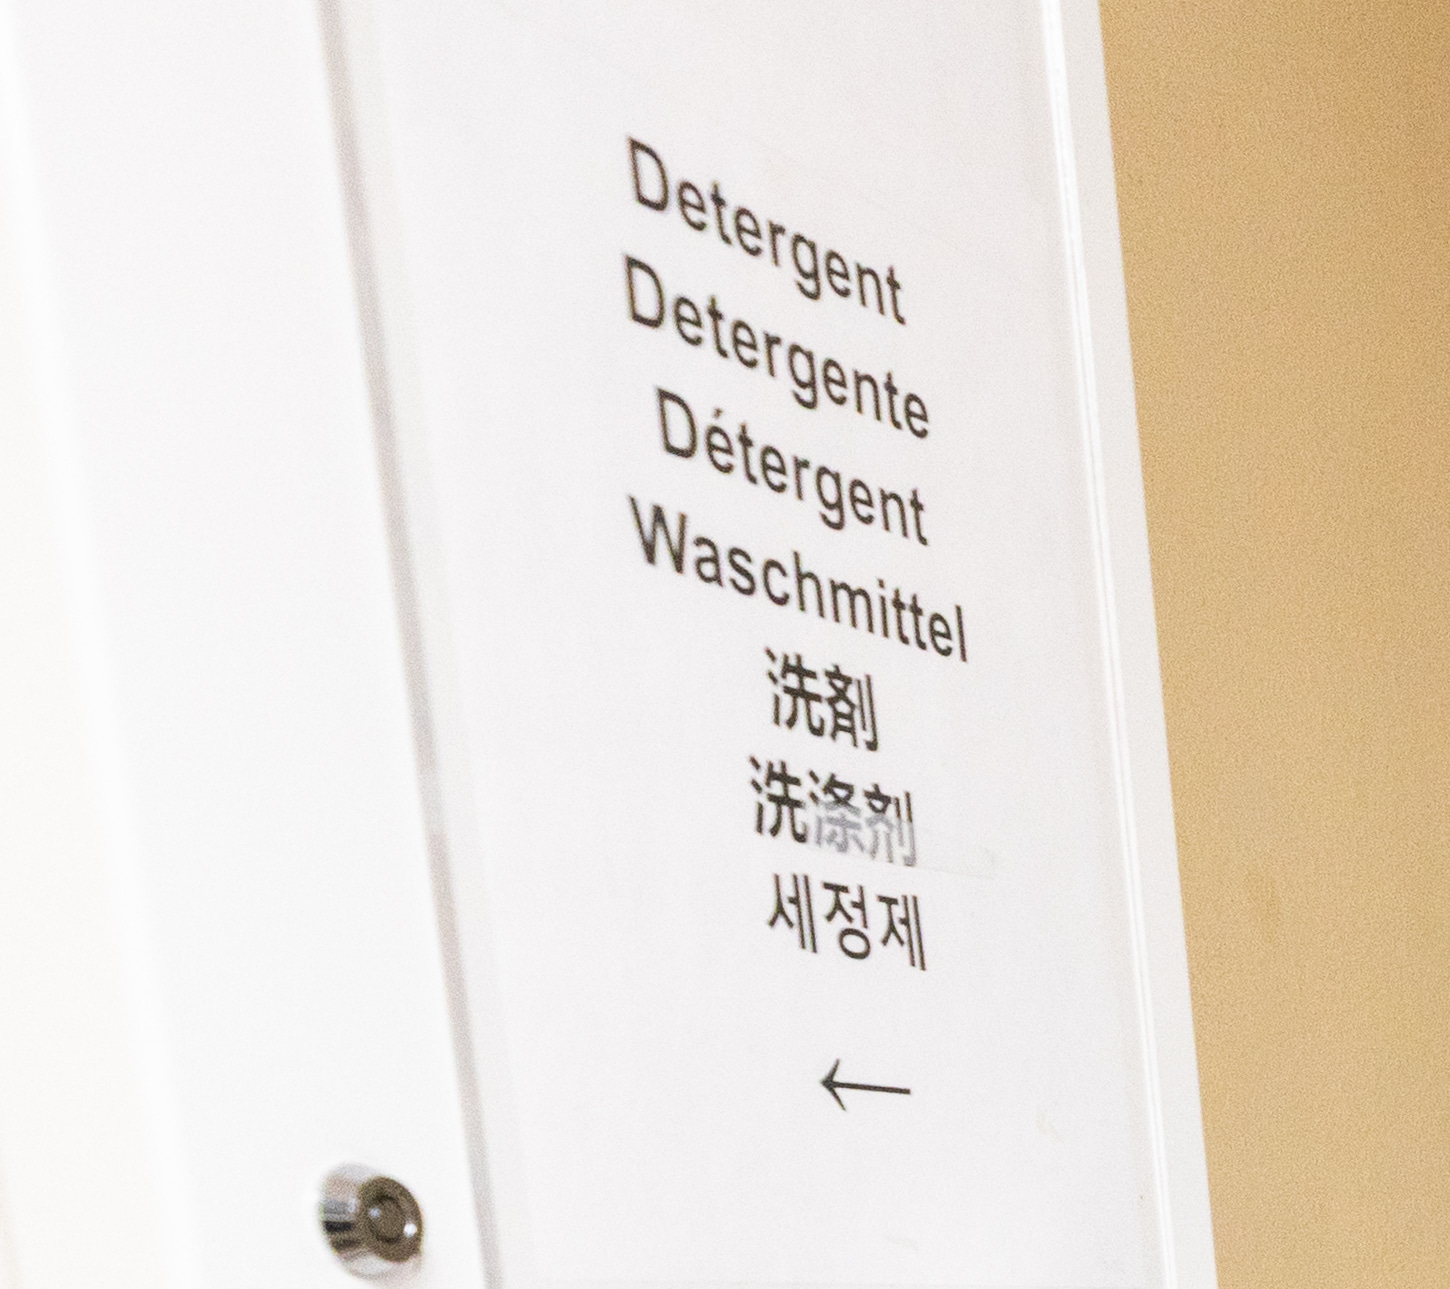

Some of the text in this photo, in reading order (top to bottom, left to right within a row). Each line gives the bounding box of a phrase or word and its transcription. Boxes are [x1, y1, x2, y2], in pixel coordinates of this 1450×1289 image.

[627, 136, 906, 325] Detergent
[624, 254, 929, 439] Detergente
[656, 387, 929, 546] Détergent
[627, 495, 969, 662] Waschmittel
[764, 646, 878, 751] 洗剤
[749, 755, 917, 868] 洗涤剂
[767, 872, 926, 971] 세정제
